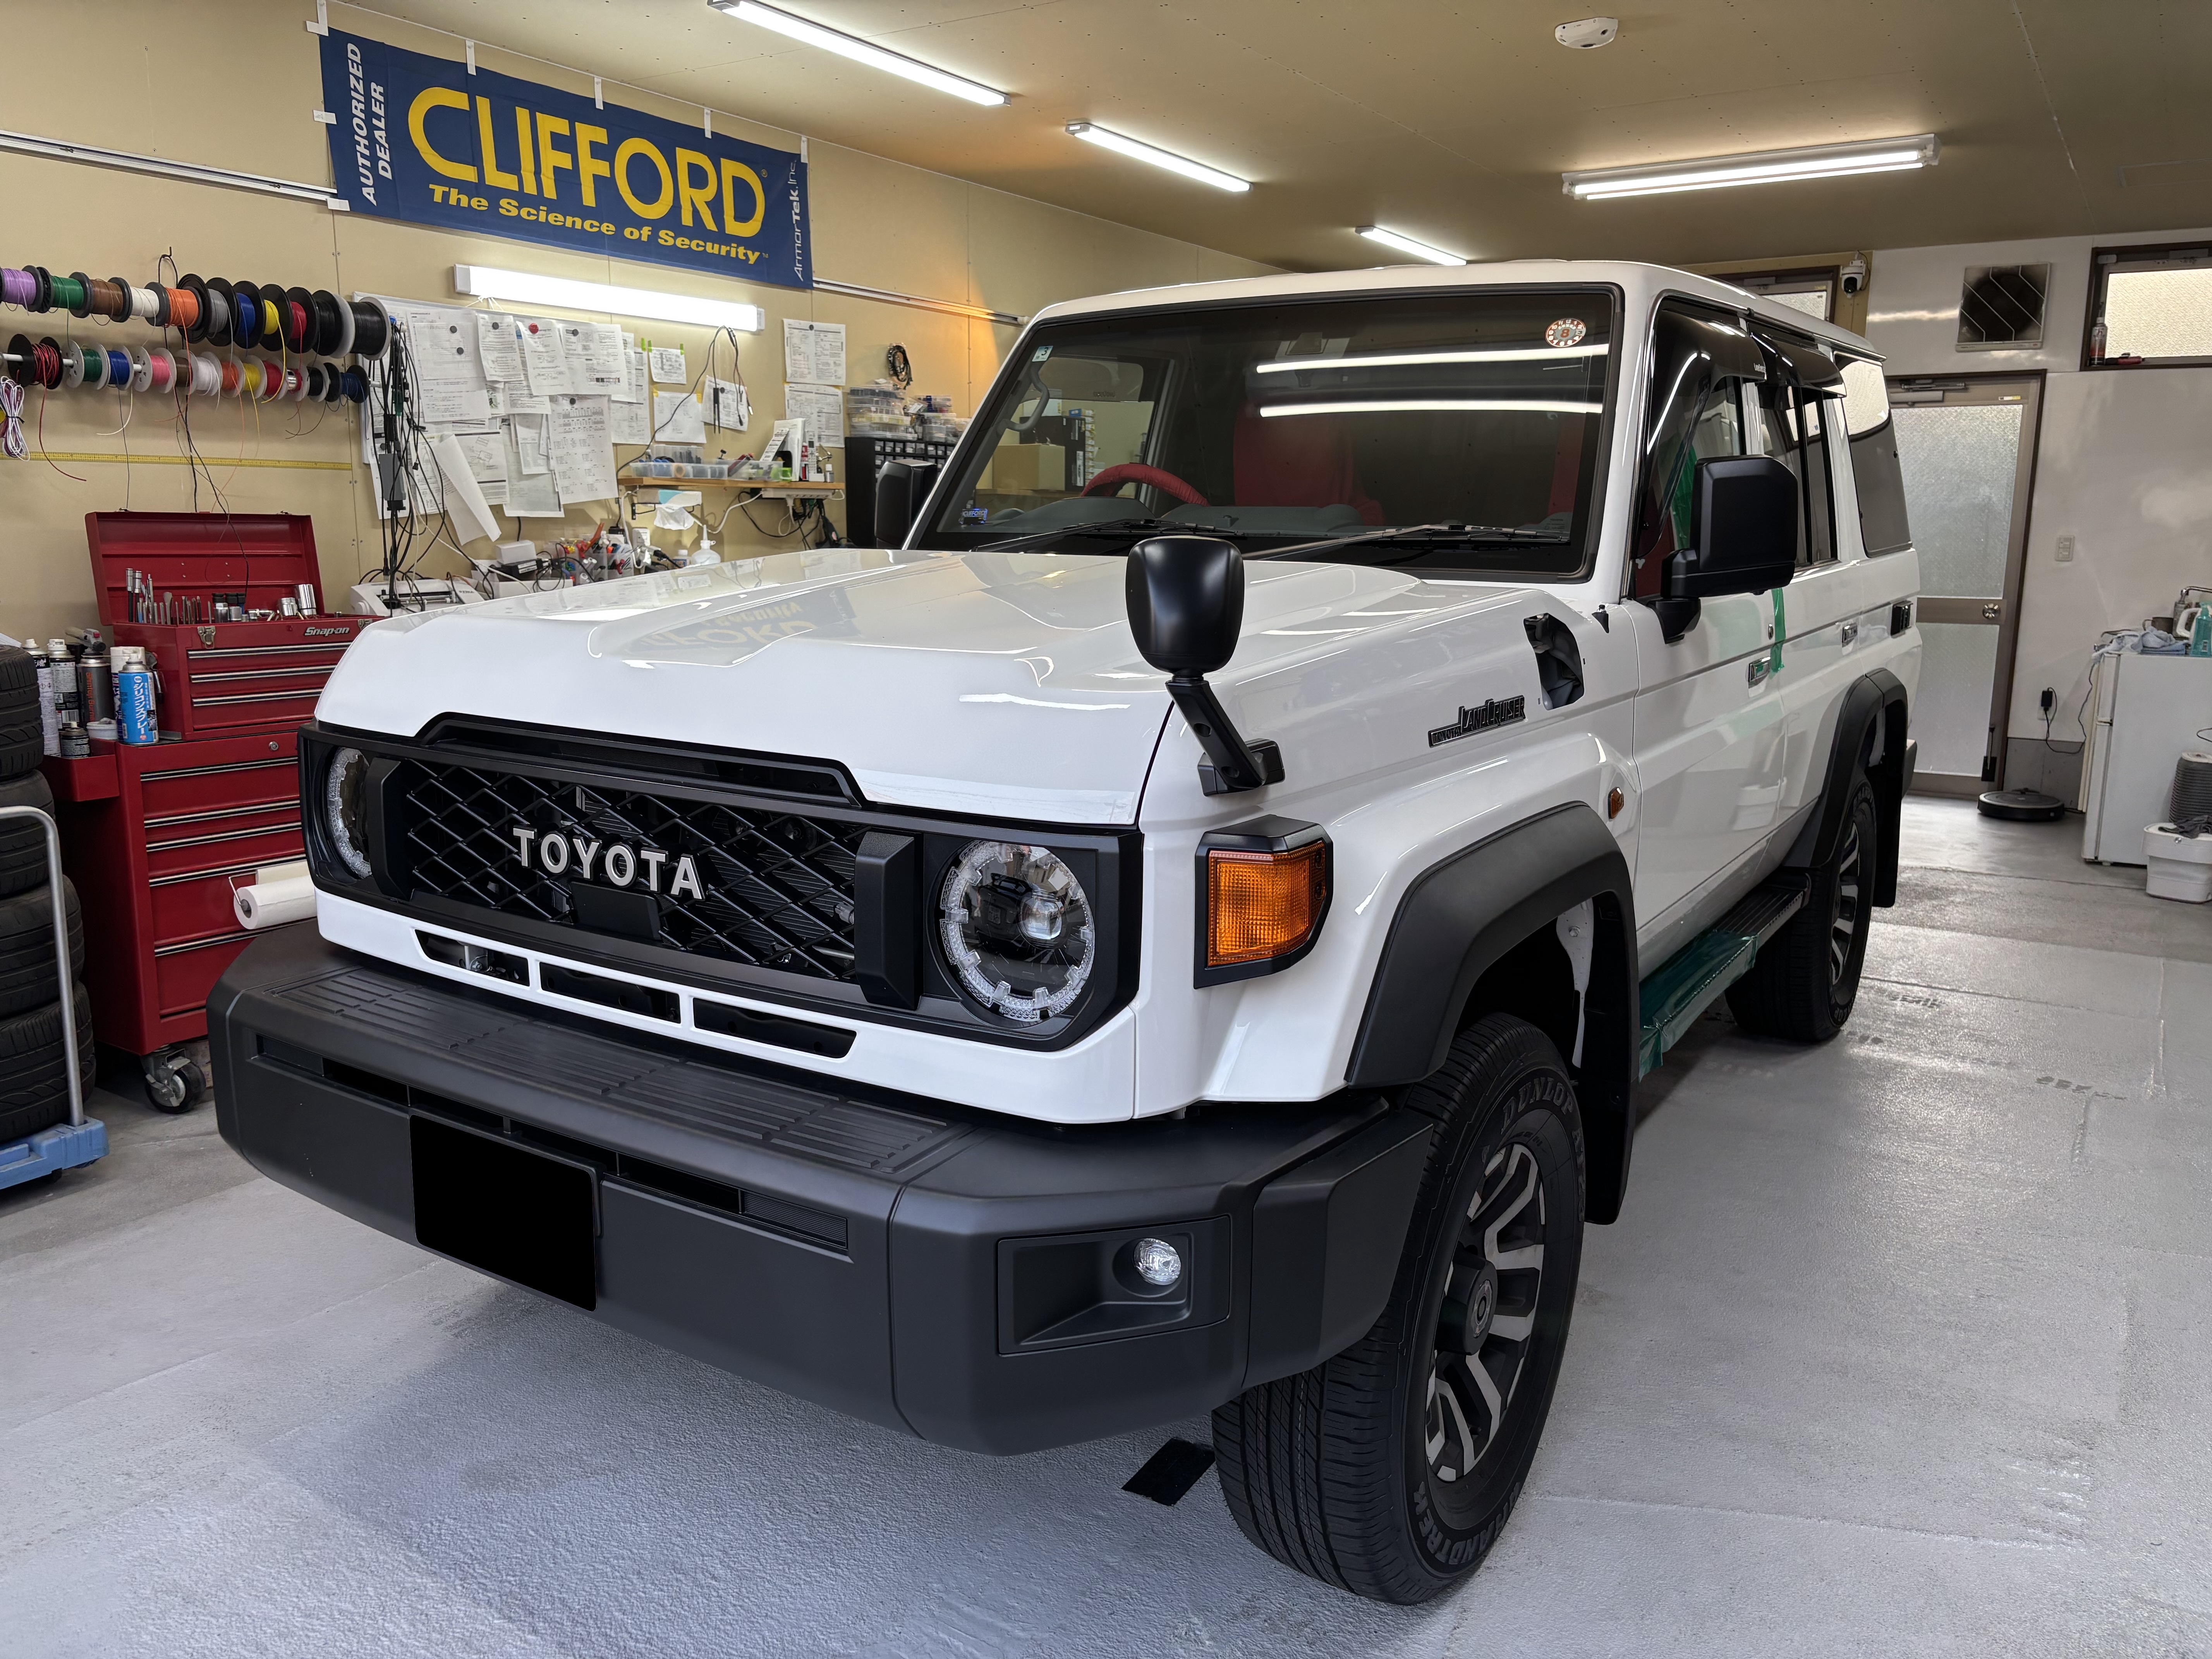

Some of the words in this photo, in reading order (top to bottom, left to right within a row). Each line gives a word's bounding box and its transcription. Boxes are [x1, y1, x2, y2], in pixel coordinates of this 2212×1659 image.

[347, 43, 377, 206] AUTHORIZED
[370, 82, 393, 180] DEALER
[408, 86, 766, 237] CLIFFORD
[429, 184, 489, 210] The
[498, 198, 616, 235] Science
[624, 225, 652, 242] of
[658, 230, 760, 264] Security
[1041, 347, 1049, 356] 3
[1560, 328, 1570, 338] 8
[134, 682, 148, 734] シリコンスプレー
[513, 825, 706, 900] TOYOTA
[1501, 1077, 1575, 1134] DUNLOP
